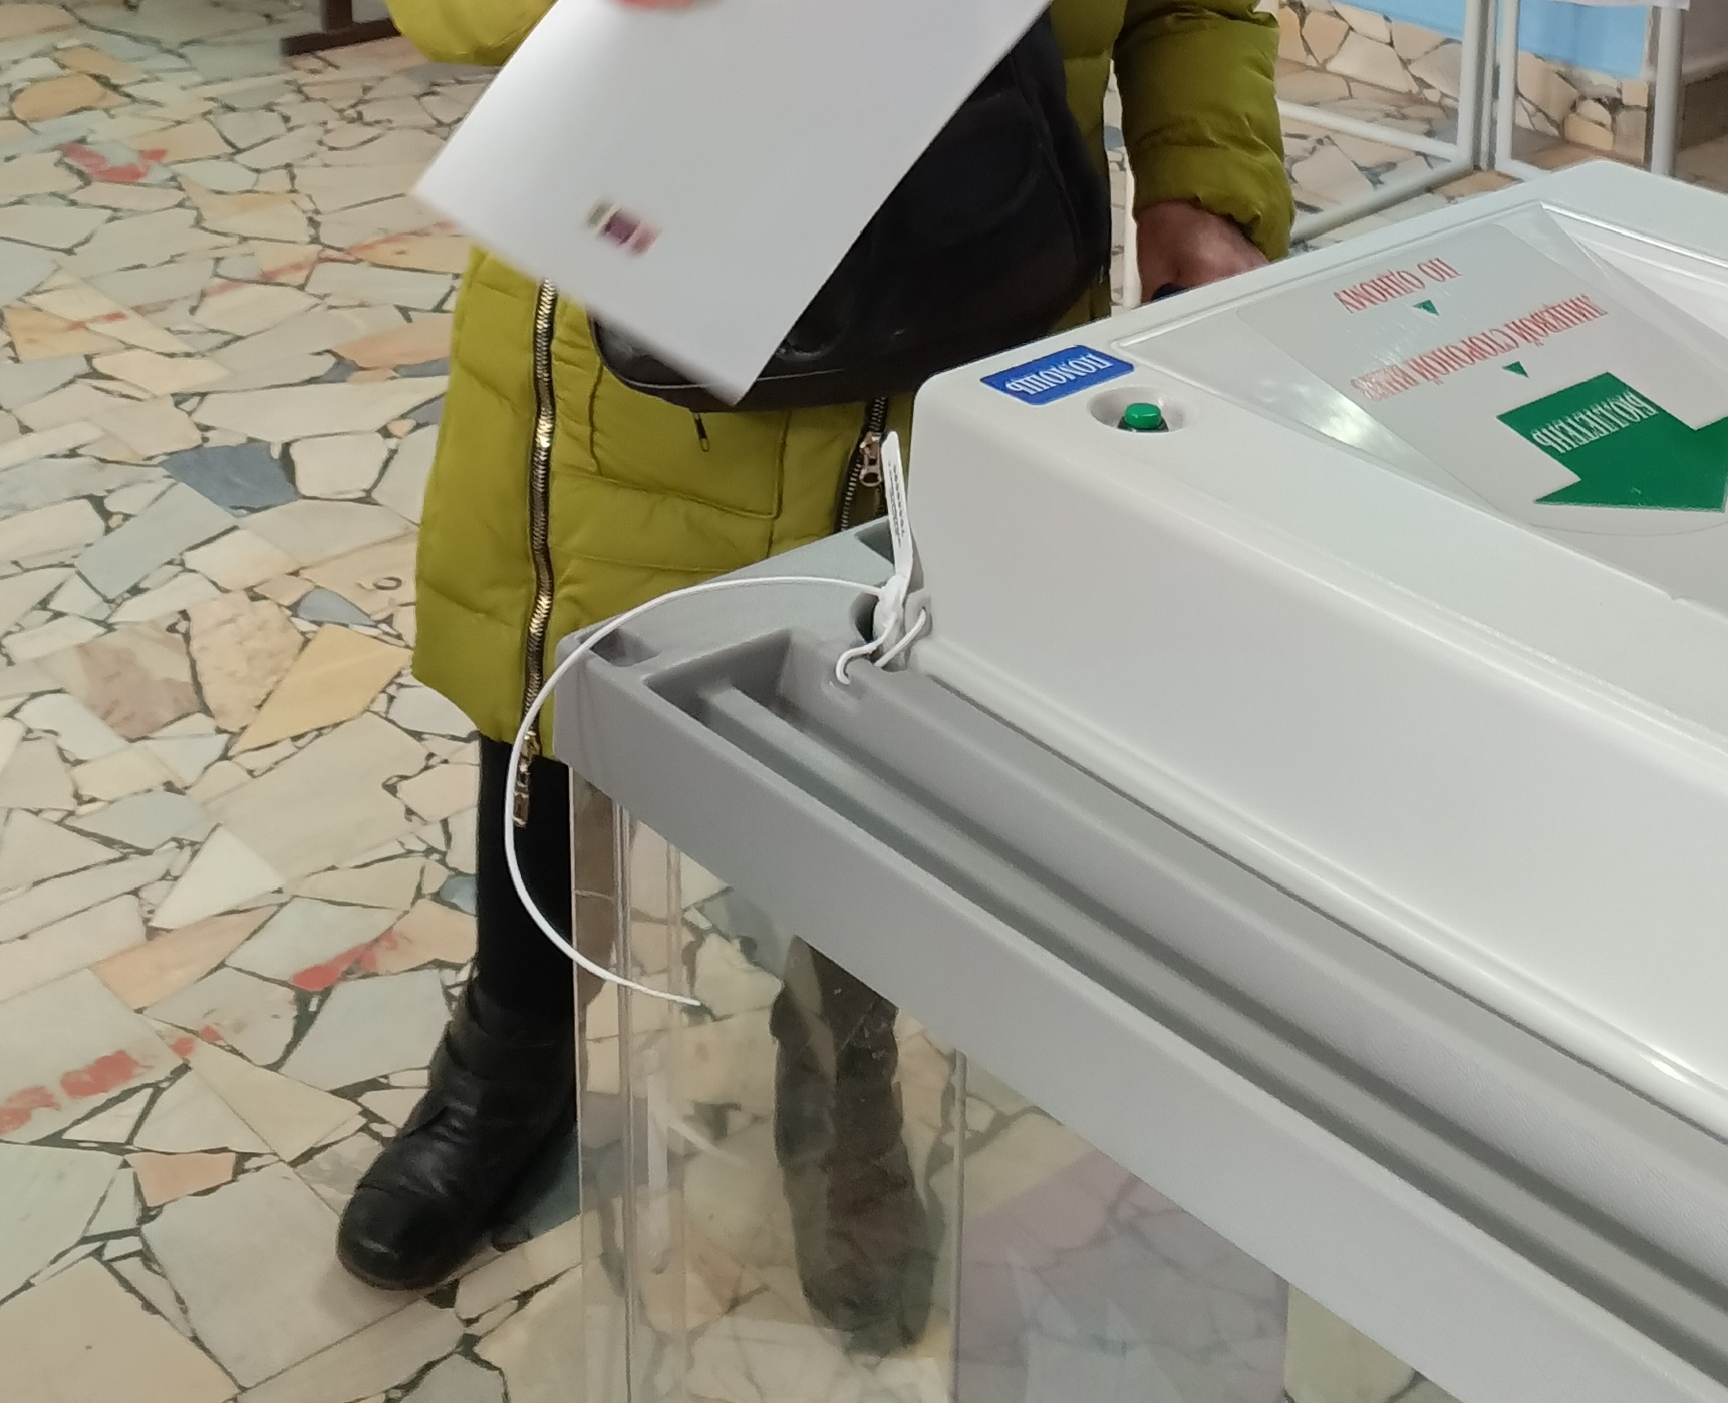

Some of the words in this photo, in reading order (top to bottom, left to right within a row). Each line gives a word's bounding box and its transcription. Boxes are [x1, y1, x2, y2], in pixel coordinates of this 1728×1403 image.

[1333, 268, 1425, 314] ОДНОМУ
[1417, 257, 1462, 282] ПО
[1504, 294, 1608, 347] ЛИЦЕВОЙ
[1005, 353, 1114, 395] ПОМОЩЬ
[1405, 328, 1520, 386] СТОРОНОЙ
[1531, 389, 1659, 454] БЮЛЛЕТЕНЬ
